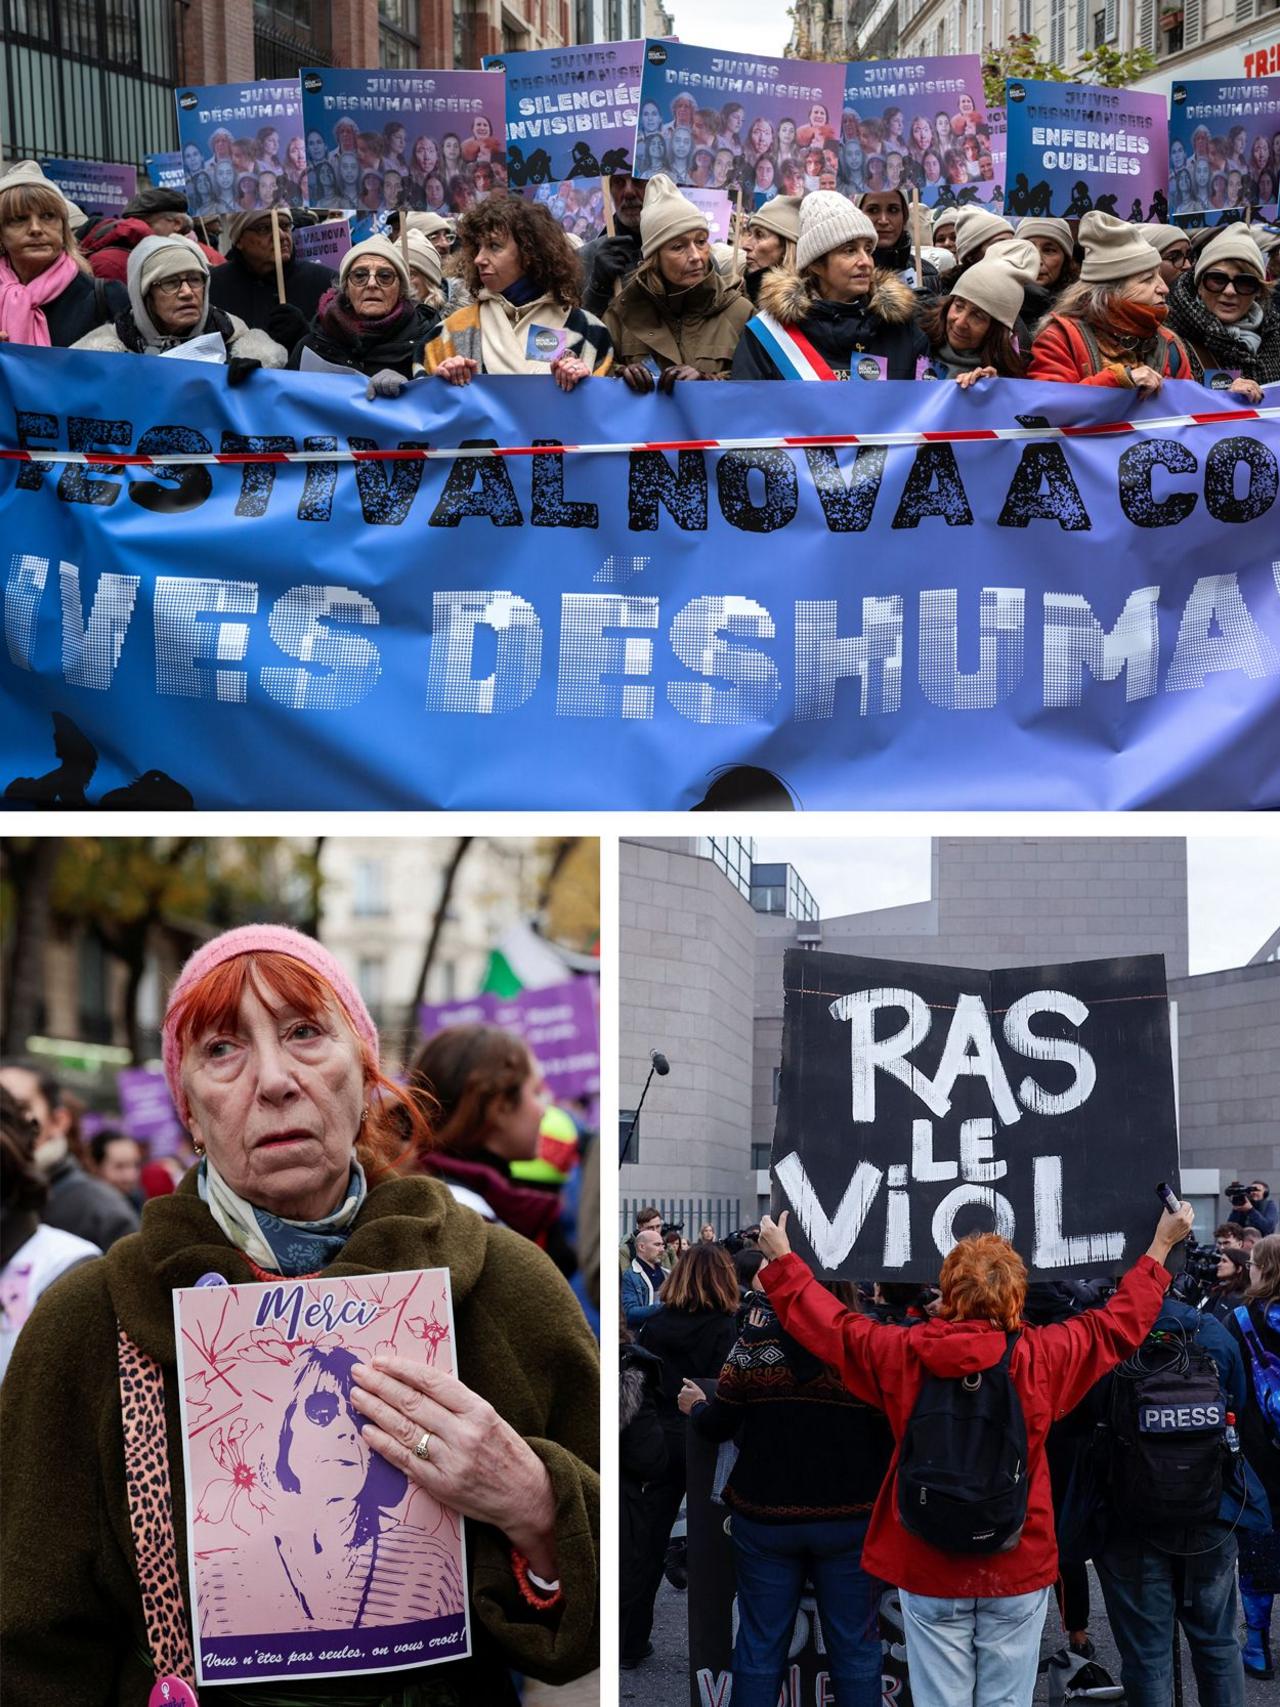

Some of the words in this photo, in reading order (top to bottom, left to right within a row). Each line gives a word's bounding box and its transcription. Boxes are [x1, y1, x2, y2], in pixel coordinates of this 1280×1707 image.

[711, 58, 780, 79] JUIVES
[865, 65, 925, 83] JUIVES
[366, 78, 436, 93] JUIVES
[1218, 85, 1269, 101] JUIVES
[199, 103, 301, 123] DÉSHUMAN
[1032, 127, 1149, 154] ENFERMÉES
[1042, 151, 1141, 176] OUBLIÉES
[15, 411, 599, 529] FESTIVAL
[628, 445, 974, 533] NOVA
[997, 414, 1092, 531] À
[828, 987, 1097, 1125] RAS
[912, 1117, 1007, 1182] LE
[255, 1286, 378, 1341] Merci
[1146, 1407, 1219, 1428] PRESS
[203, 1652, 238, 1668] Vous
[242, 1650, 283, 1665] n'êtes
[287, 1651, 313, 1665] pas
[318, 1645, 366, 1660] seules,
[372, 1646, 390, 1656] on
[394, 1641, 424, 1654] vous
